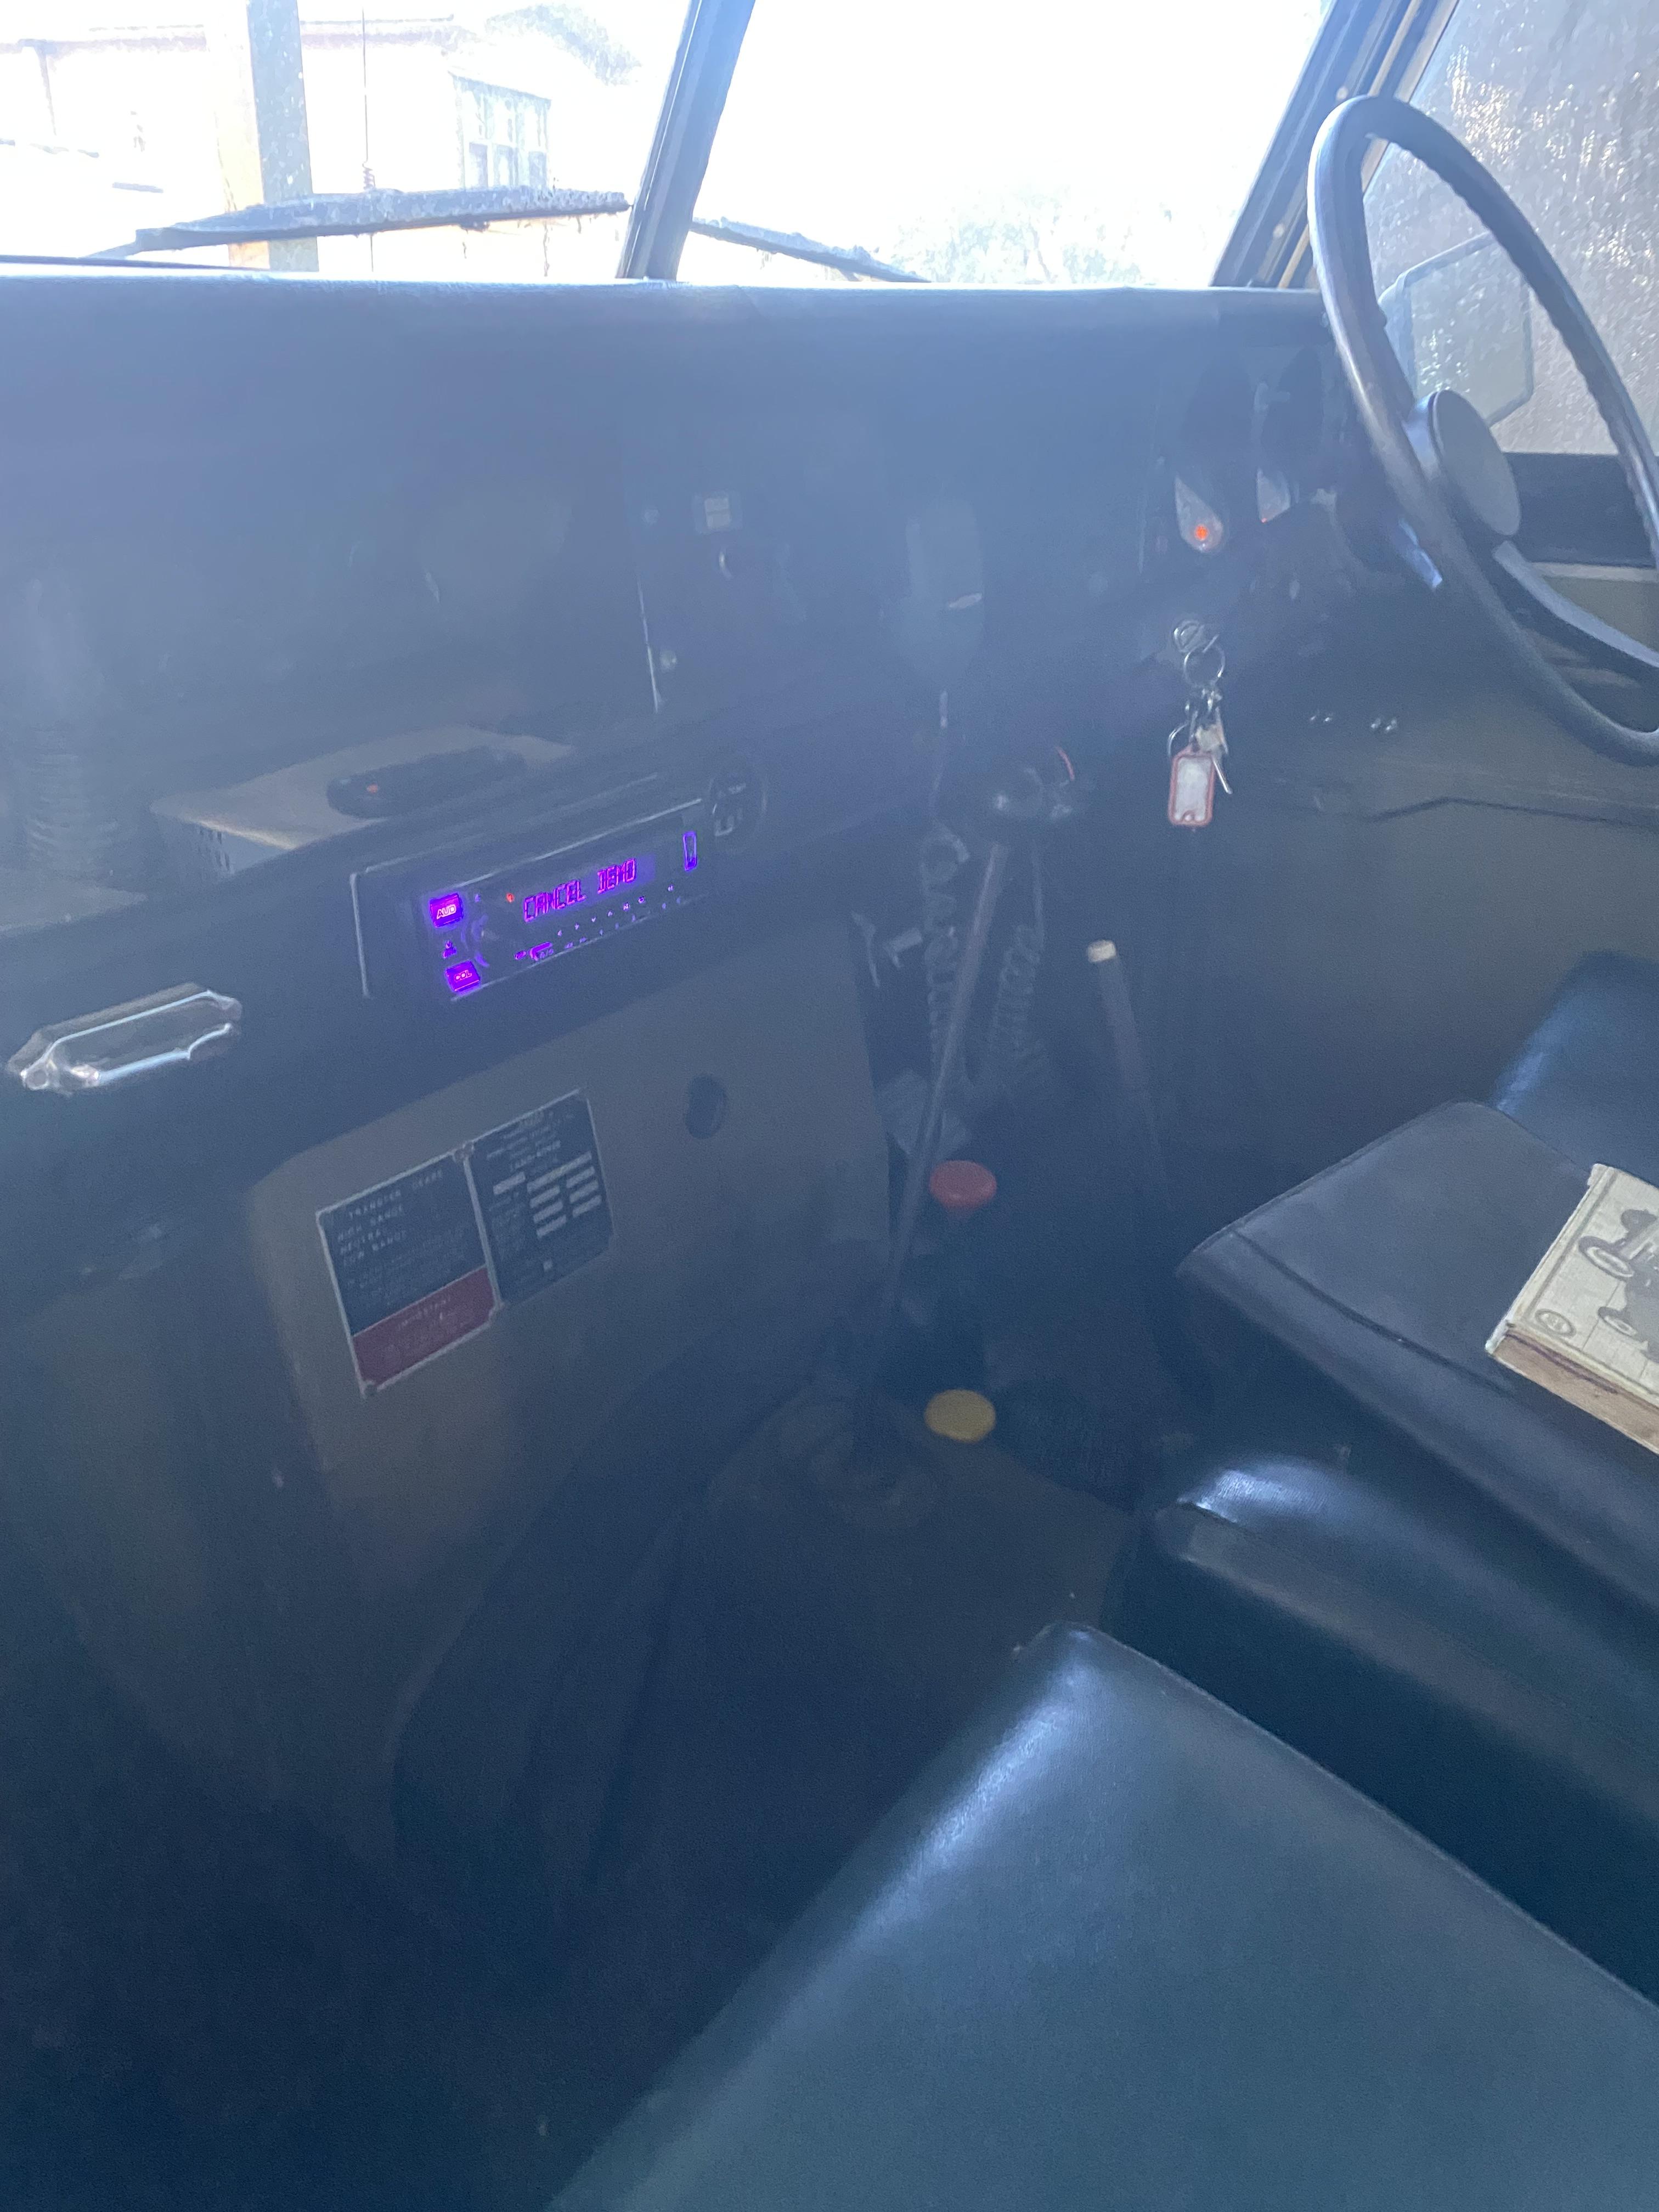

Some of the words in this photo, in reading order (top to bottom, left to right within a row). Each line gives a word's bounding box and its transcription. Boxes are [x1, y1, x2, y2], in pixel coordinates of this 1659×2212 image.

[524, 878, 586, 922] CANCEL
[597, 857, 636, 894] DEMO
[436, 904, 456, 919] AUD
[454, 969, 472, 983] COL
